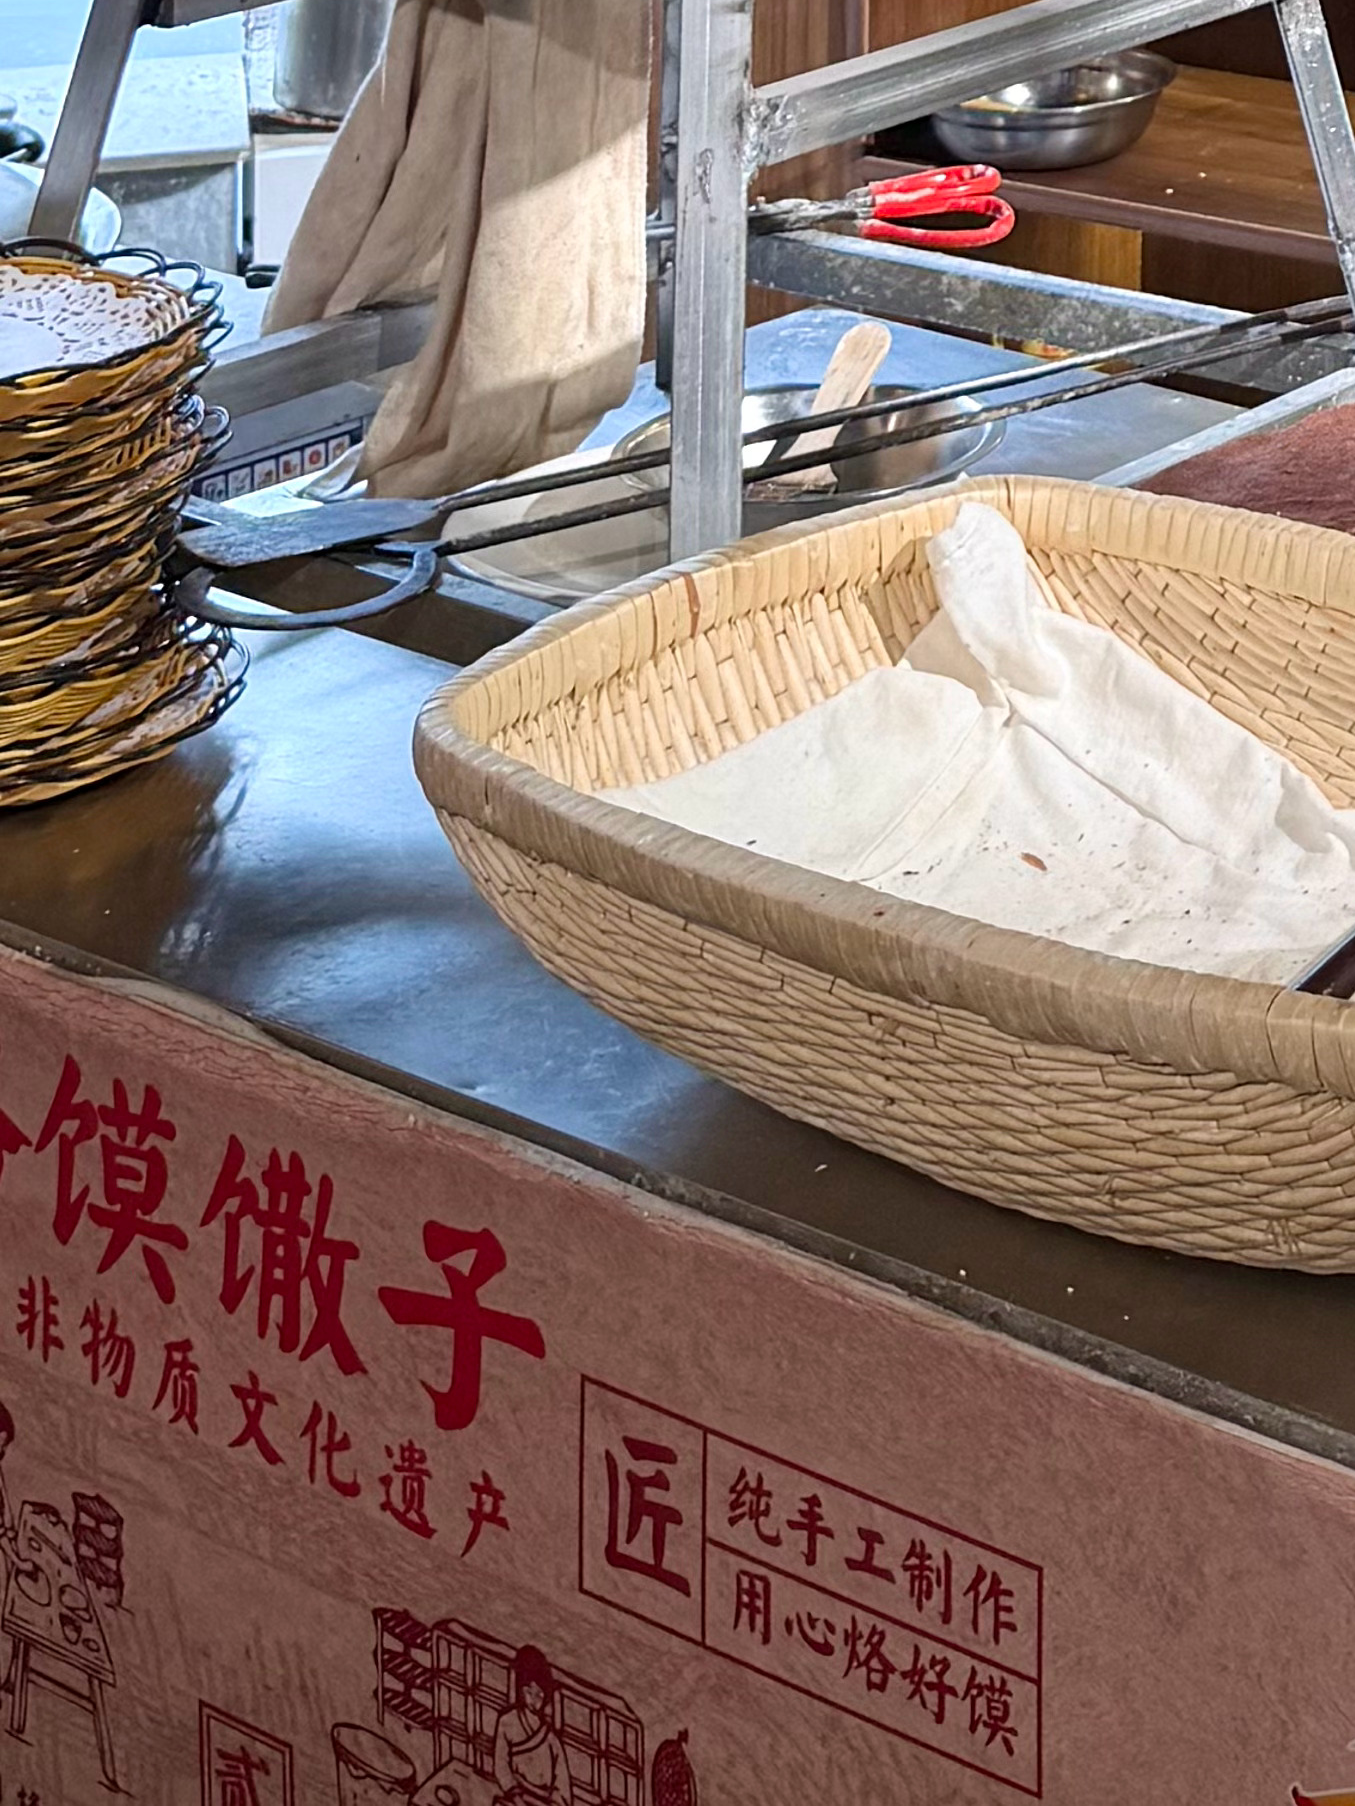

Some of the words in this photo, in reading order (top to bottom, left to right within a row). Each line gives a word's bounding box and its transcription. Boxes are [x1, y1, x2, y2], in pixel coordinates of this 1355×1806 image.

[0, 1052, 546, 1432] 馍馓子
[16, 1274, 511, 1559] 非物质文化遗产
[604, 1435, 692, 1600] 匠
[726, 1465, 1020, 1648] 纯手工制作
[732, 1570, 1020, 1761] 用心烙好馍
